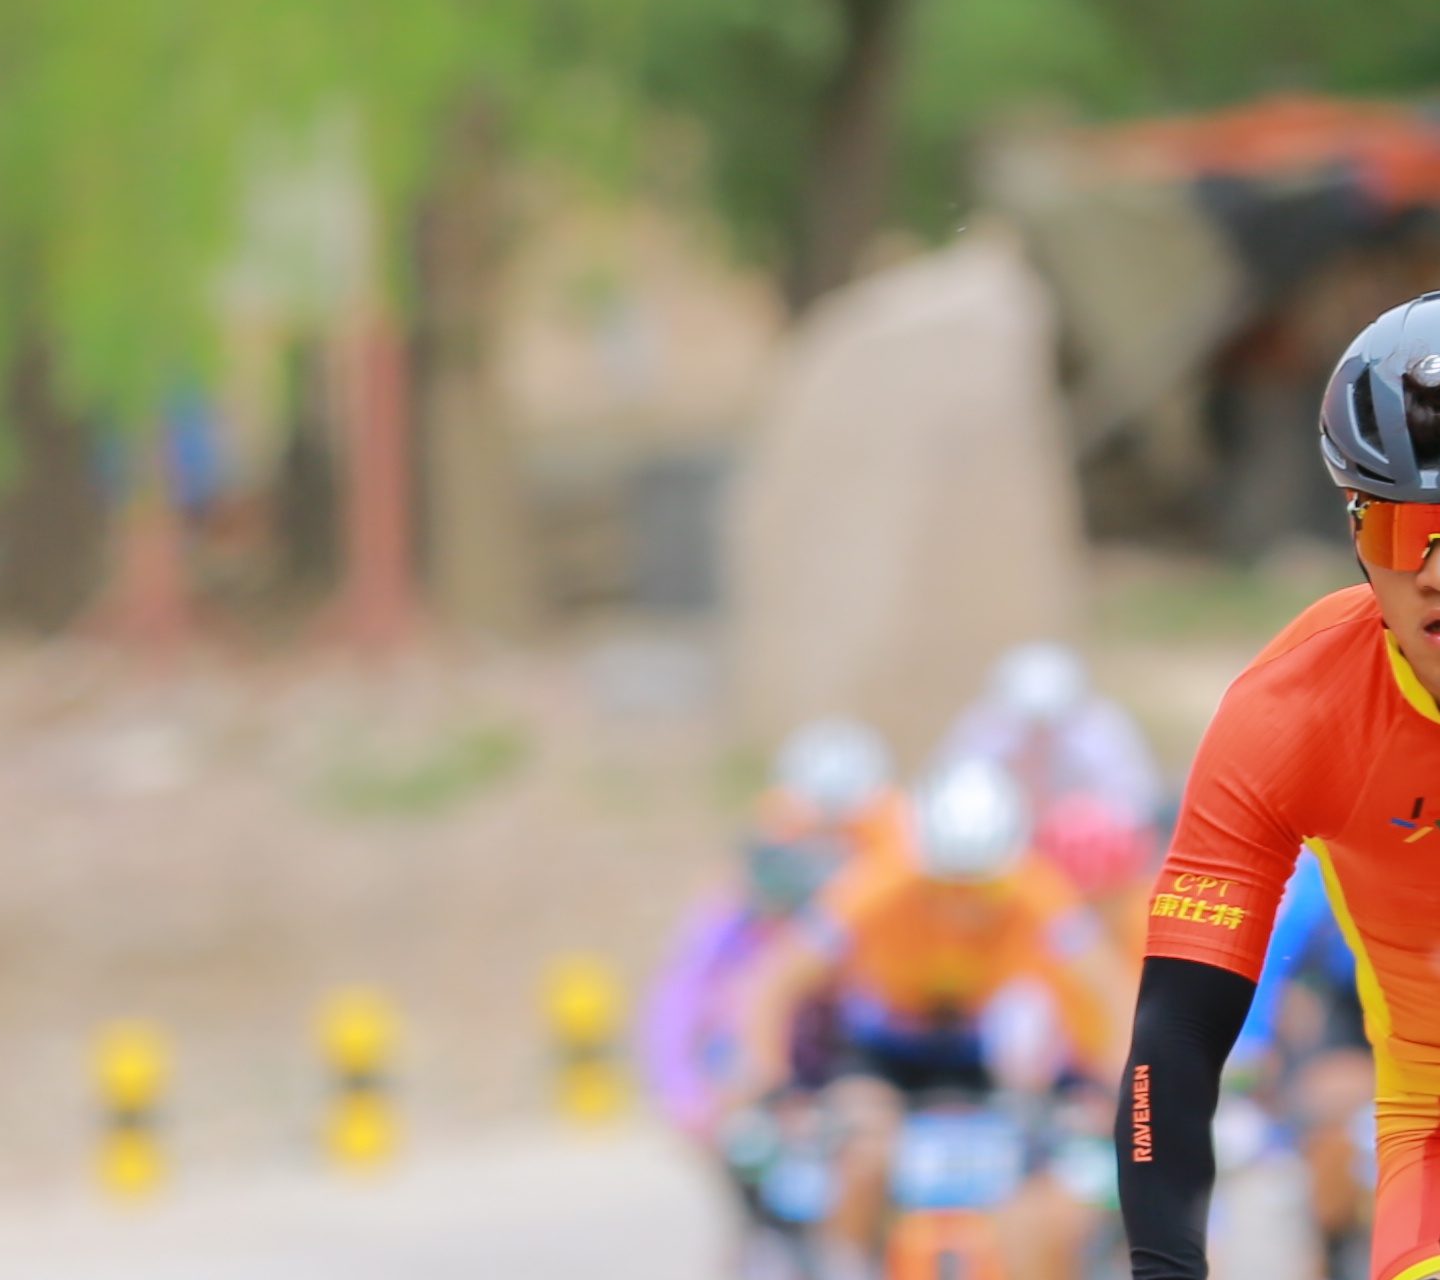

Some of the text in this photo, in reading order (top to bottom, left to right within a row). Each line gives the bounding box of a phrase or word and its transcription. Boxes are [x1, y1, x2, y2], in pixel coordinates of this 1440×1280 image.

[1150, 893, 1250, 930] 康比特
[1132, 1064, 1154, 1163] RAVEMEN
